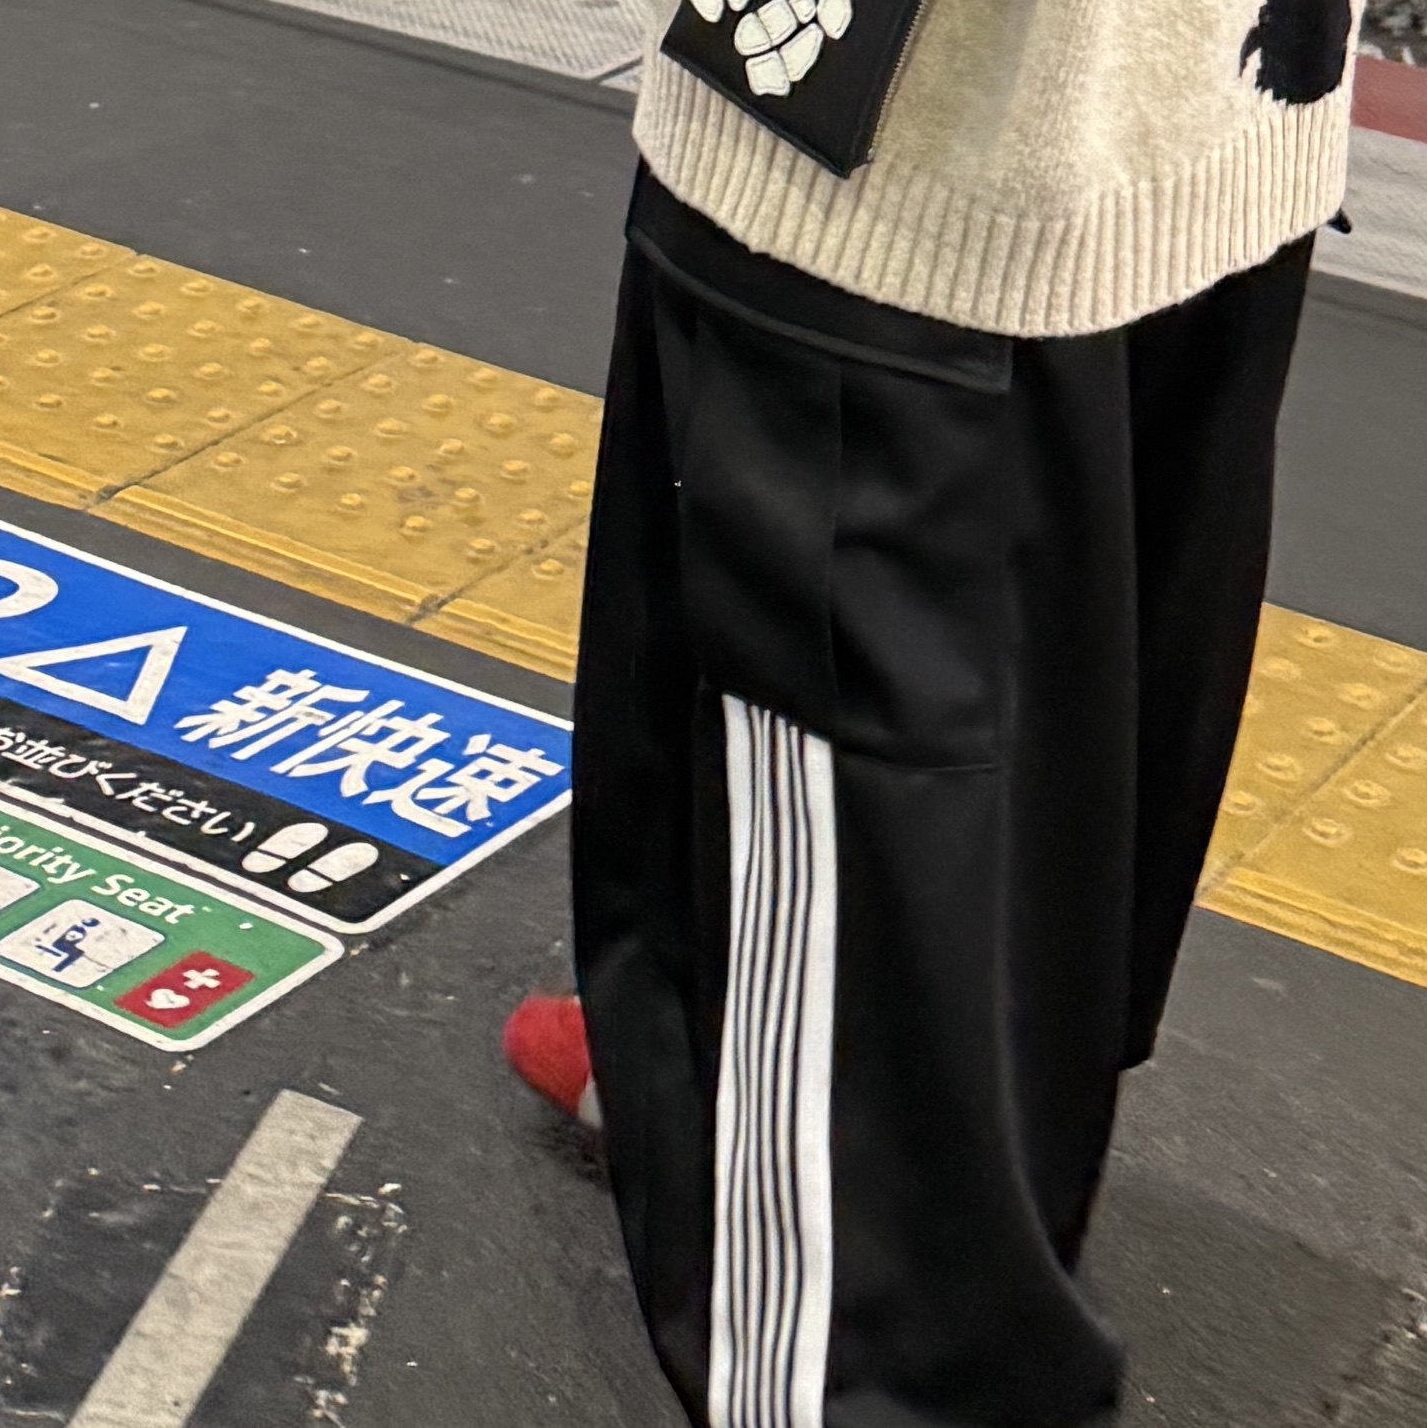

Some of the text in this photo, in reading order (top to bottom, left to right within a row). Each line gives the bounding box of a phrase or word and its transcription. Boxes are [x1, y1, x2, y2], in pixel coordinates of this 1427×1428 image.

[173, 668, 566, 838] 新快速
[92, 872, 196, 927] Seat
